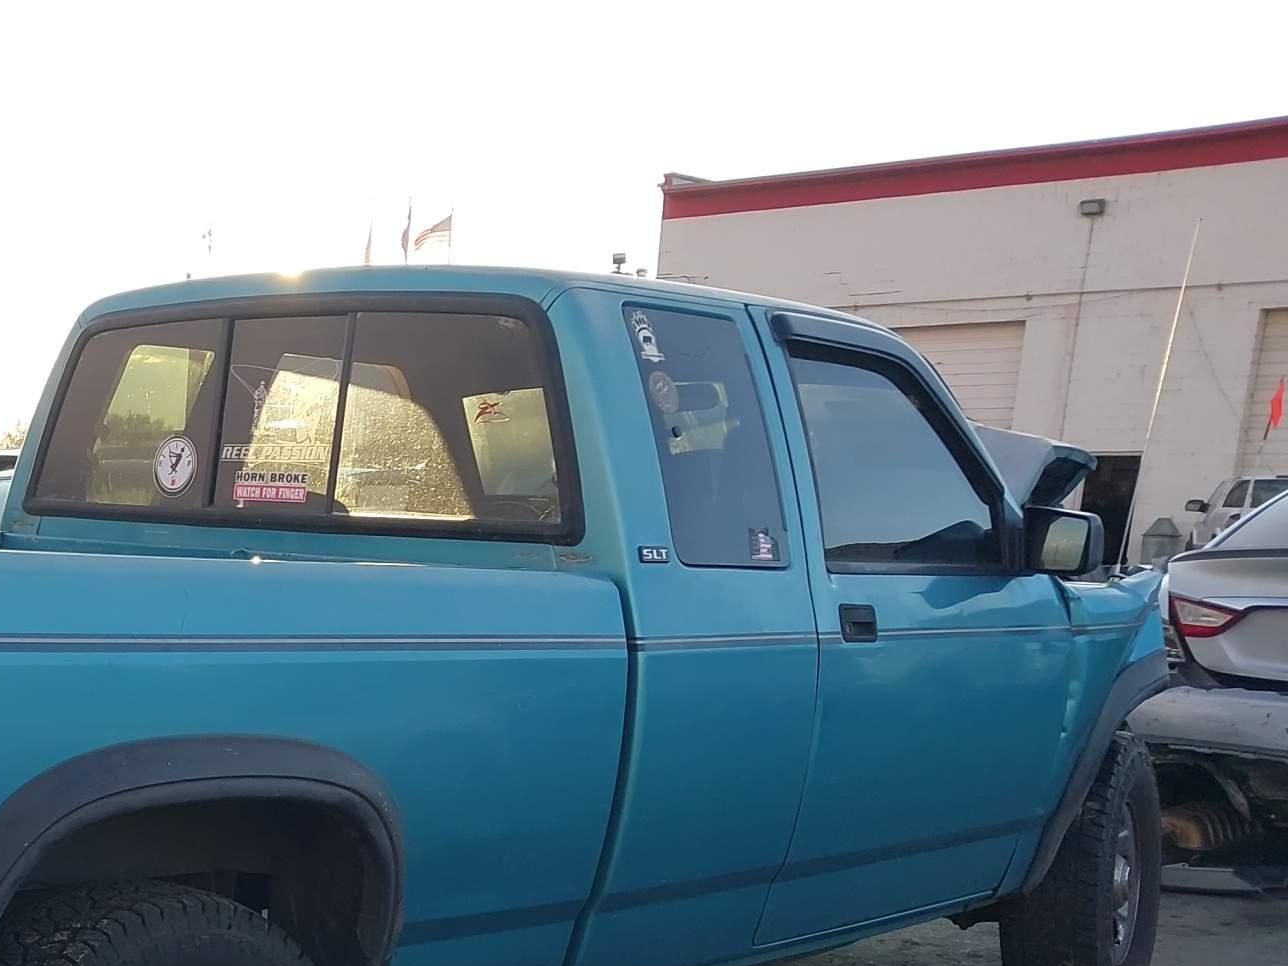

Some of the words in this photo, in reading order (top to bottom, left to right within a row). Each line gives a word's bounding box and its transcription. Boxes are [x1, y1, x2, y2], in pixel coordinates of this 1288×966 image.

[221, 446, 257, 459] REEL
[261, 446, 329, 460] PASSION
[236, 472, 266, 483] HORN
[270, 473, 308, 484] BROKE
[236, 486, 261, 498] WATCH
[262, 487, 277, 499] FOR
[278, 488, 306, 500] FINGER
[642, 549, 668, 560] SLT
